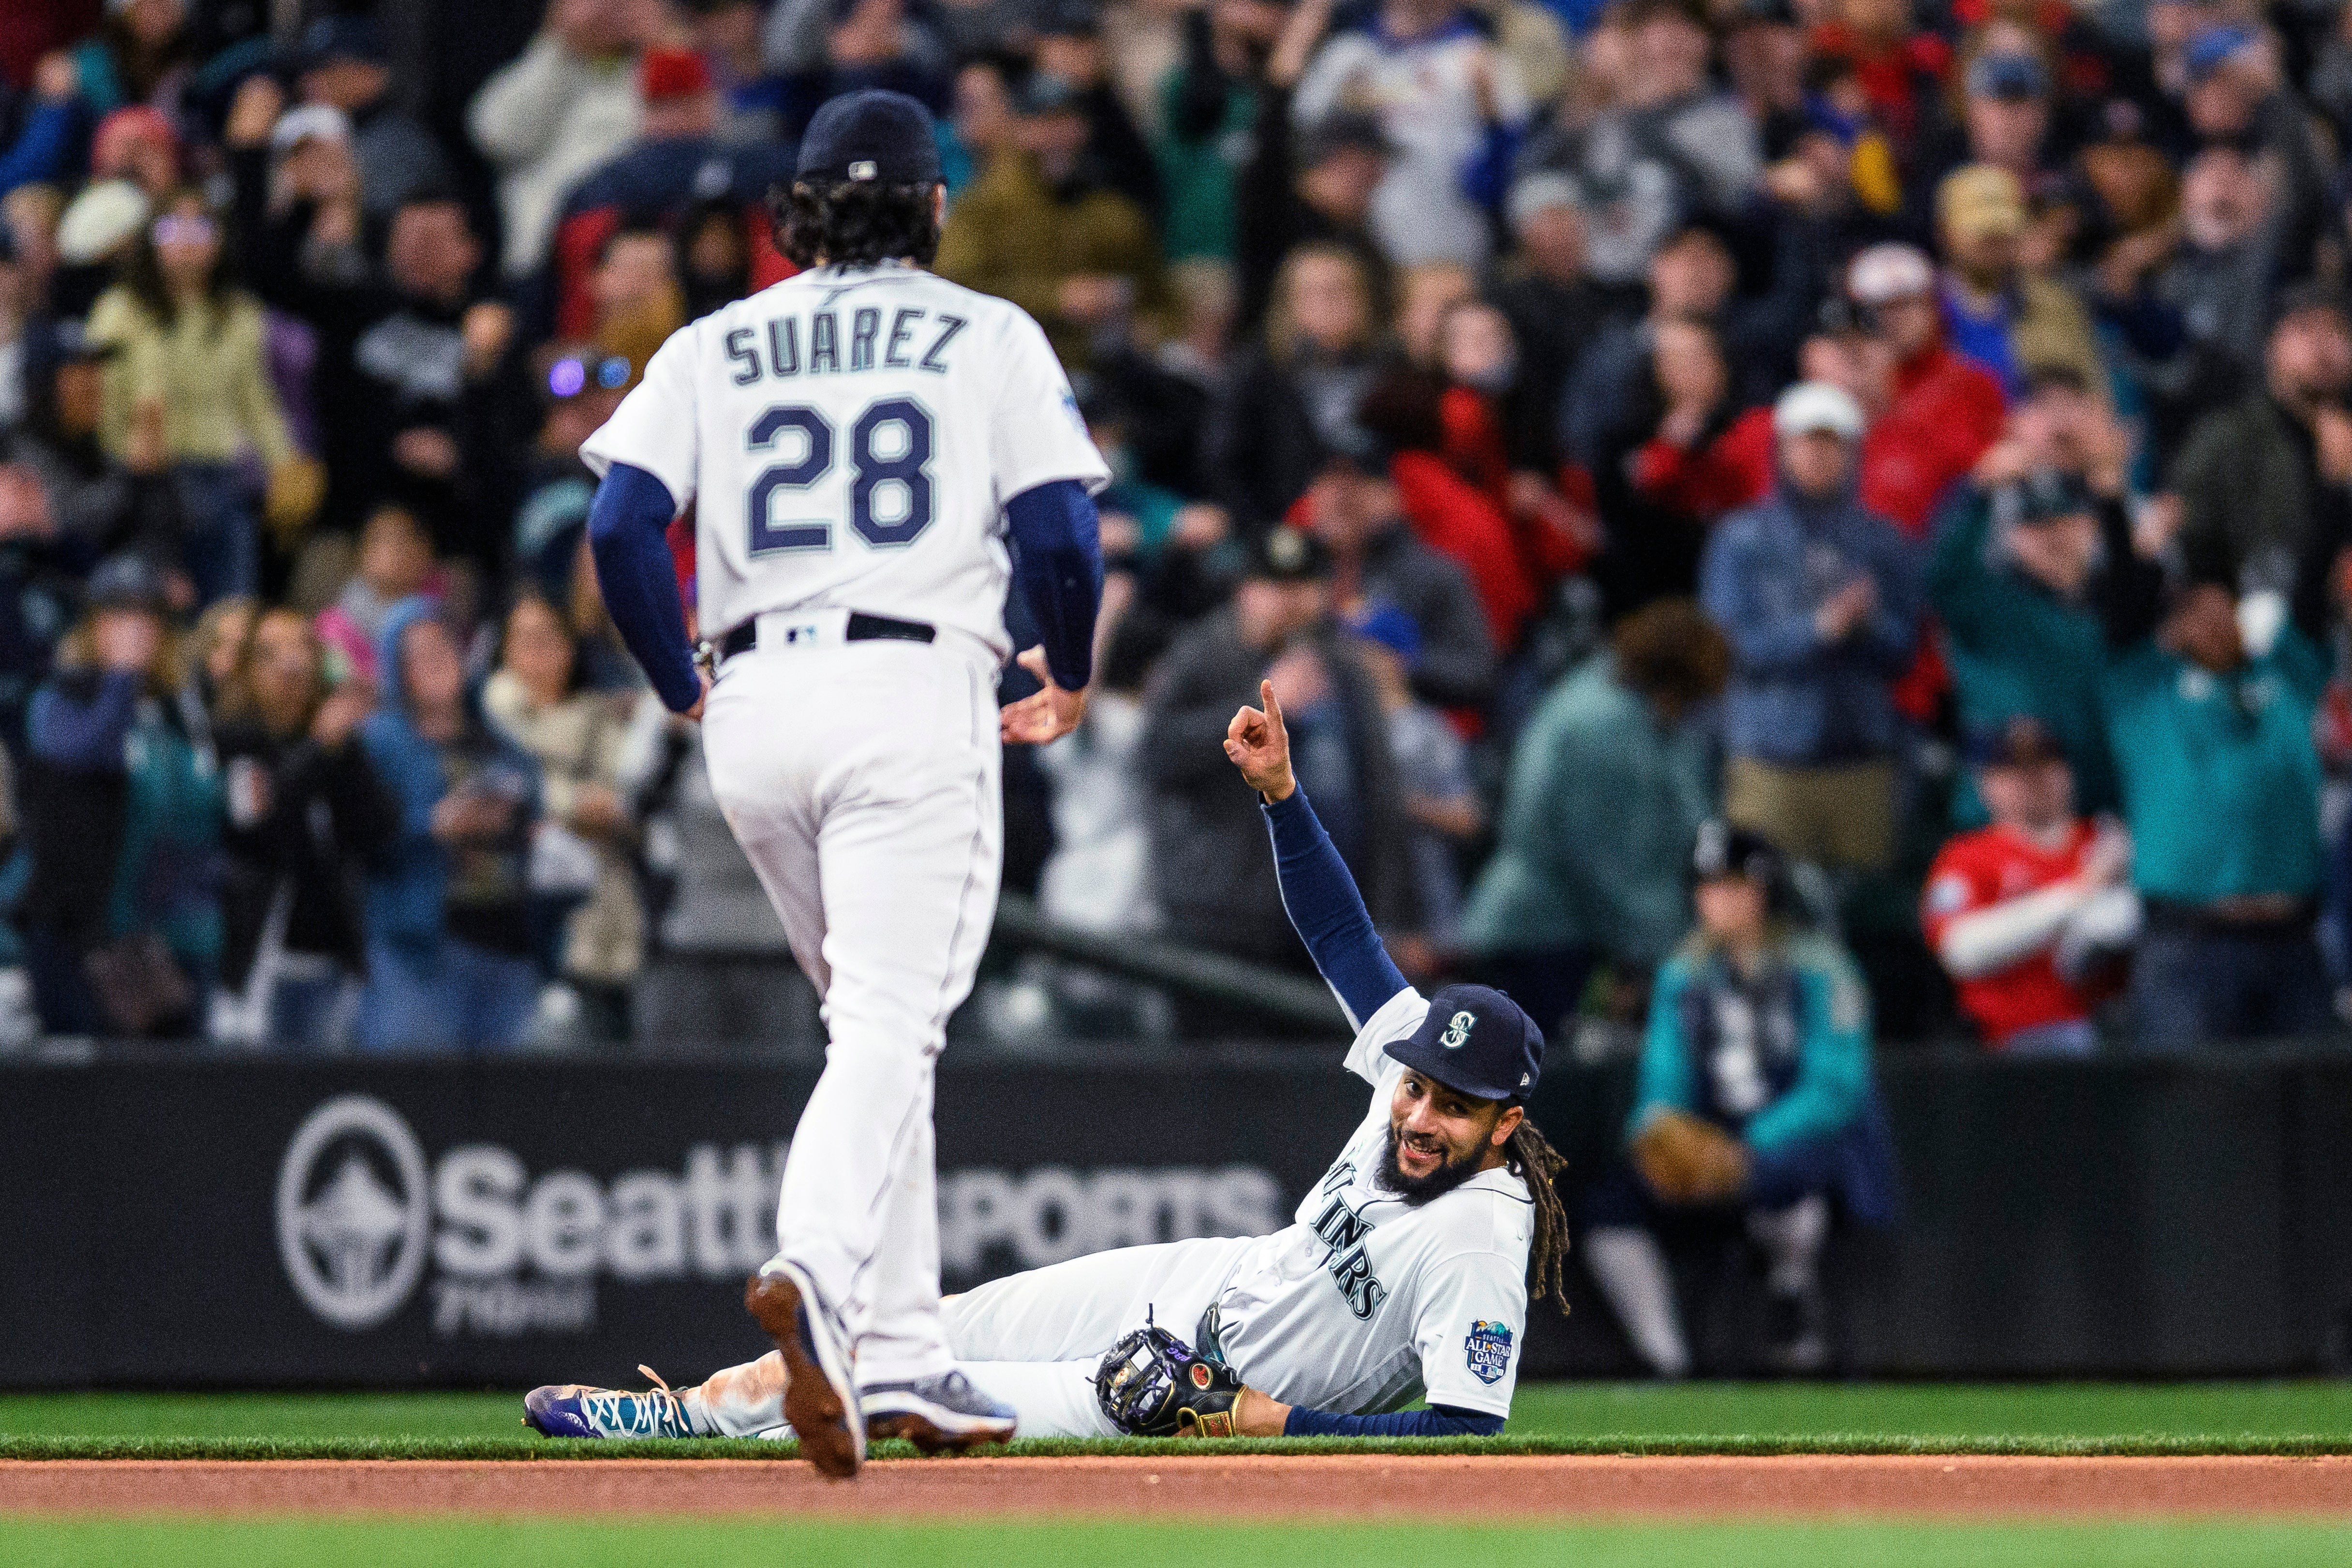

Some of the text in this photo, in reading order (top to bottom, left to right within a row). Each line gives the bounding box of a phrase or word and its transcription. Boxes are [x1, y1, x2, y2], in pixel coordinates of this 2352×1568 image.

[745, 393, 937, 559] 28
[1438, 1010, 1478, 1049] S
[432, 1141, 1287, 1279] Seatt PORTS
[1465, 1338, 1511, 1357] ALL STAR
[1482, 1334, 1504, 1343] SEATTLE
[1475, 1351, 1504, 1367] GAME
